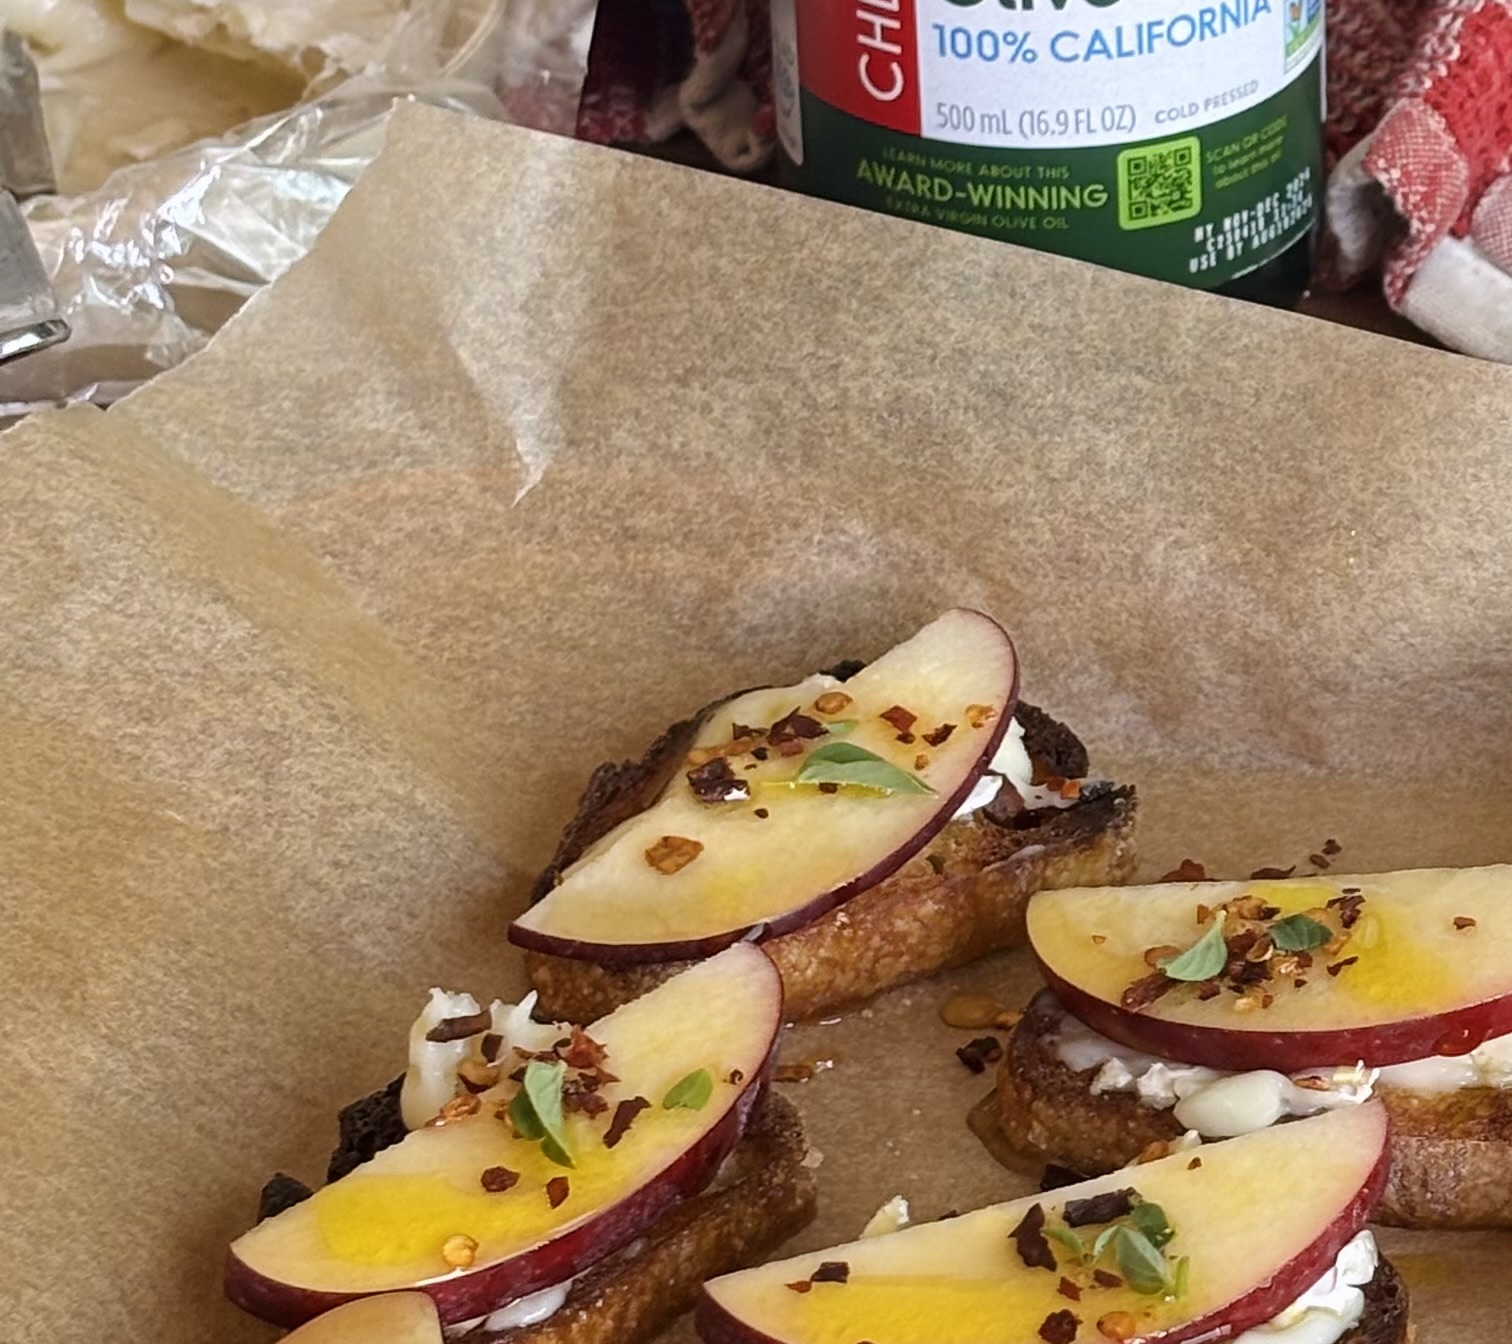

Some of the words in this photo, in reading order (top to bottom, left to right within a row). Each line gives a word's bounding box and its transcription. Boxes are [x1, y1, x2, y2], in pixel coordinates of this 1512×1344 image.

[933, 24, 1038, 63] 100%
[1154, 102, 1199, 124] COLD
[1203, 79, 1259, 113] PRESSED
[937, 102, 975, 133] 500
[980, 113, 1012, 135] mL
[1018, 108, 1069, 139] (16.9
[1075, 108, 1097, 134] FL
[1101, 104, 1136, 133] OZ)
[882, 147, 926, 167] LEARN
[930, 159, 972, 176] MORE
[979, 164, 1031, 179] ABOUT
[1037, 166, 1069, 180] THIS
[856, 158, 1109, 210] AWARD-WINNING
[937, 209, 987, 226] VIRGIN
[992, 215, 1036, 230] OLIVE
[1042, 216, 1069, 230] OIL
[1189, 251, 1217, 274] USE
